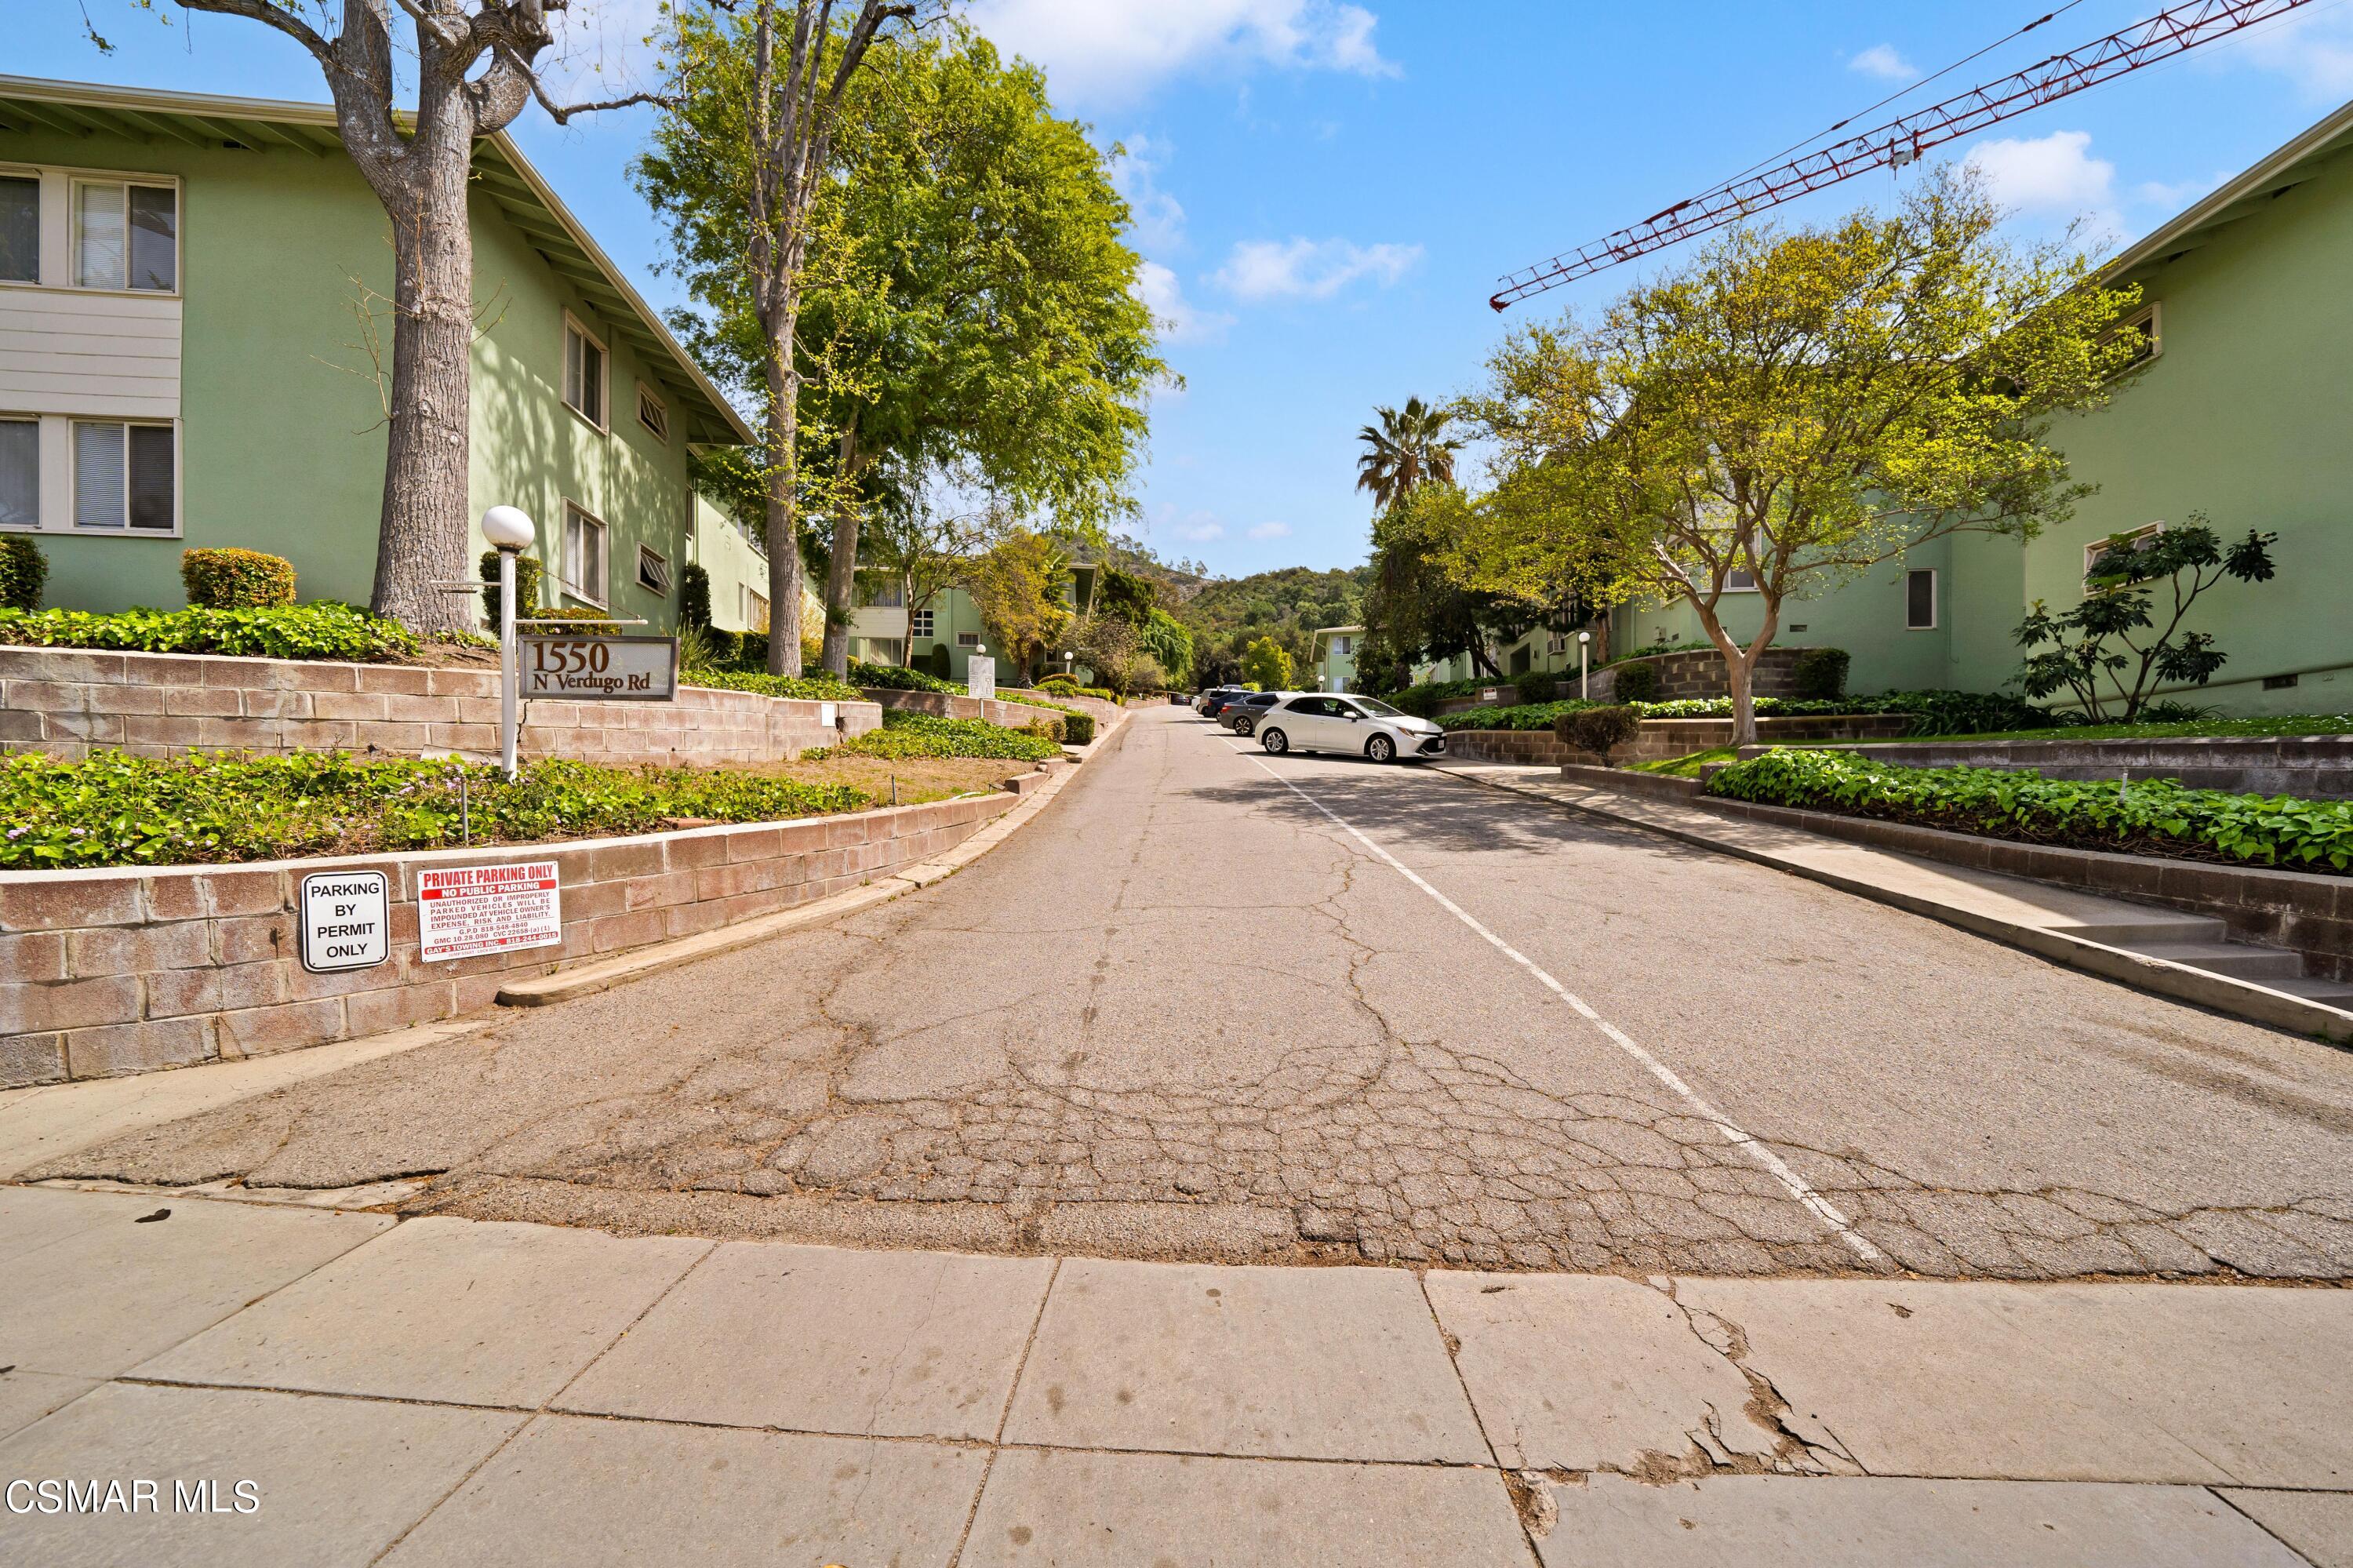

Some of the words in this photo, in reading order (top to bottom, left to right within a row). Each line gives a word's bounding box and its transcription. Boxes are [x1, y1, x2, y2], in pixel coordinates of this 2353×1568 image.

[533, 642, 609, 673] 1550
[533, 673, 547, 690] N
[556, 671, 624, 693] Verdugo
[627, 672, 651, 690] Rd
[424, 871, 474, 887] PRIVATE
[476, 867, 526, 883] PARKING
[528, 864, 553, 879] ONLY
[311, 882, 380, 898] PARKING
[442, 889, 457, 898] NO
[460, 886, 496, 897] PUBLIC
[498, 882, 540, 893] PARKING
[430, 897, 489, 908] UNAUTHORIZED
[507, 891, 550, 901] IMPROPERLY
[335, 904, 356, 916] BY
[431, 906, 466, 915] PARKED
[471, 901, 512, 911] VEHICLES
[431, 912, 478, 922] IMPOUNDED
[489, 908, 518, 916] VEHICLE
[519, 904, 551, 913] OWNER'S
[516, 911, 551, 920] LIABILITY.
[318, 922, 375, 938] PERMIT
[481, 922, 528, 933] 818-548-4840
[427, 945, 451, 955] GAY'S
[452, 941, 484, 952] TOWING
[485, 939, 502, 948] INC.
[506, 932, 557, 944] 818-244-0015
[453, 933, 489, 943] 10.28.080
[326, 943, 368, 958] ONLY
